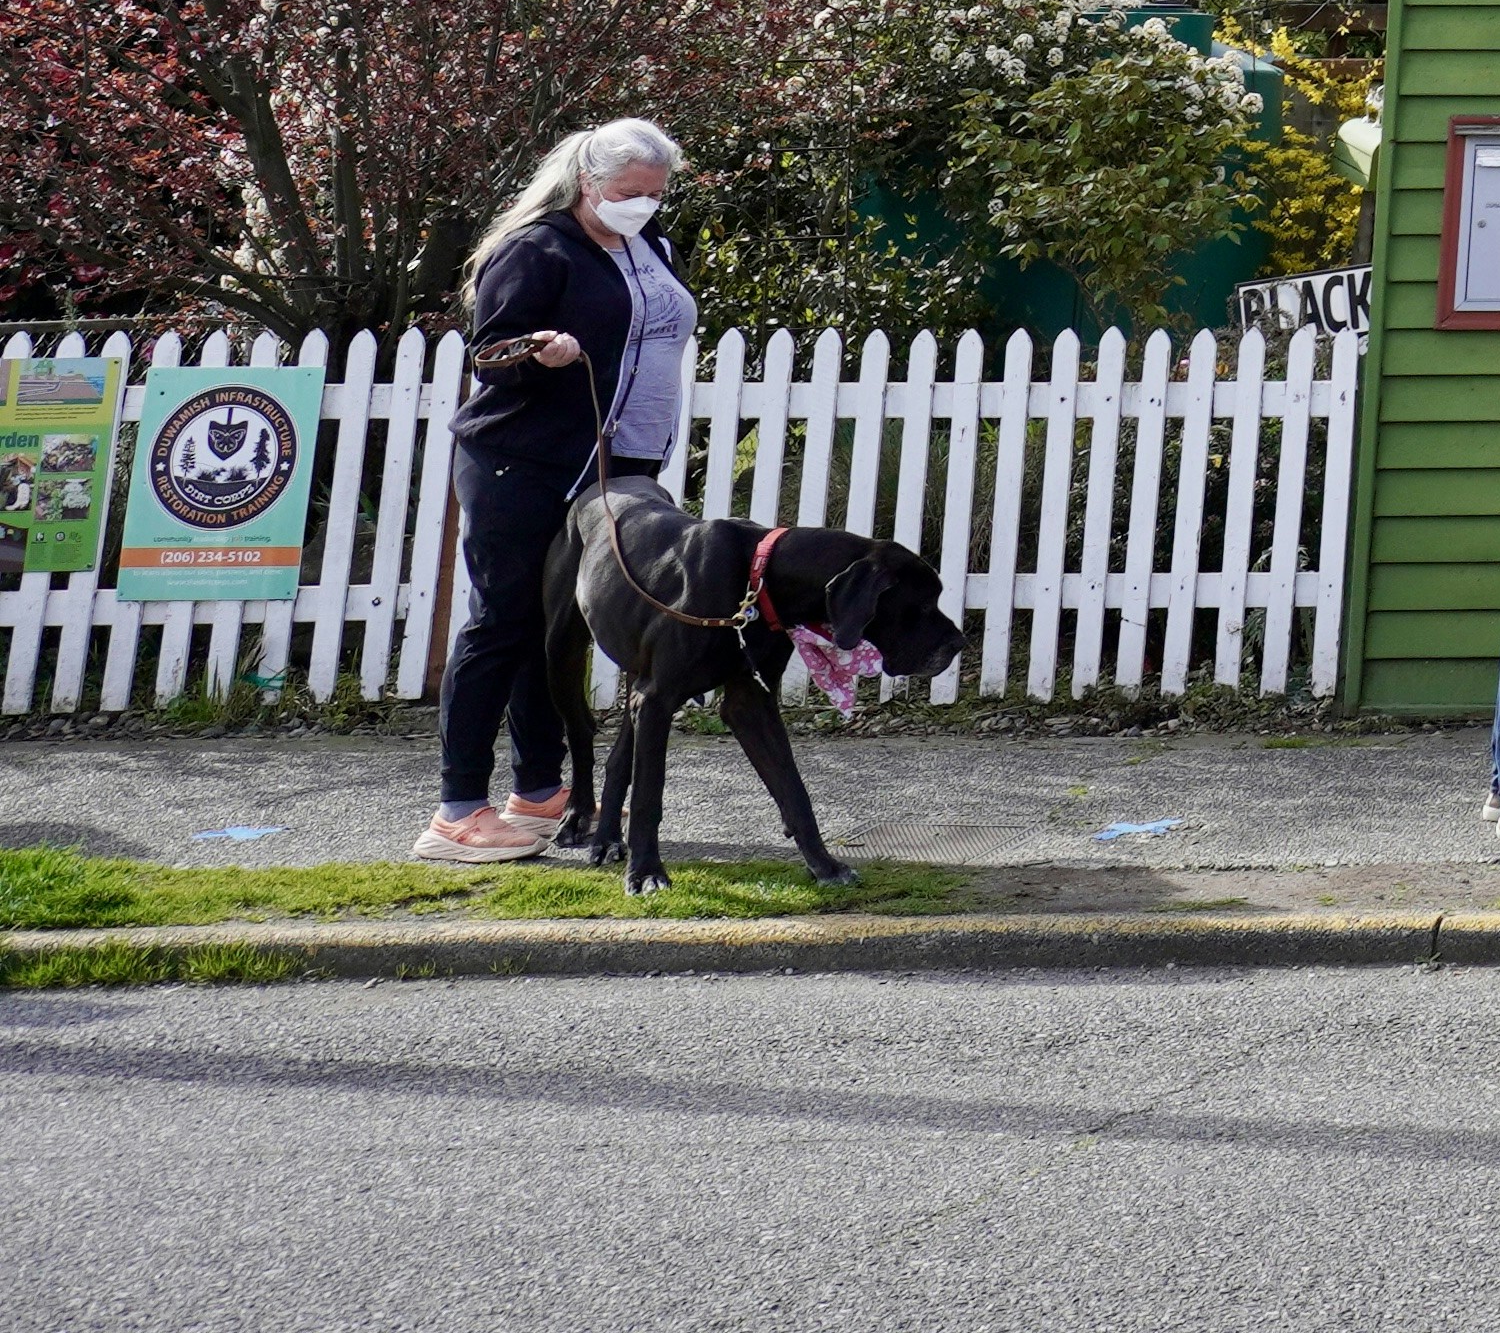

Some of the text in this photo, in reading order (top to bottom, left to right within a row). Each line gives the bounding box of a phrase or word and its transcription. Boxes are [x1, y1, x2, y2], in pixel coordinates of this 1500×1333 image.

[157, 391, 292, 457] DUWAMISH INFRASTRUCTURE
[157, 474, 285, 524] RESTORATION TRAINING
[184, 483, 255, 505] DIRT CORPS
[160, 550, 261, 565] (206) 234-5102
